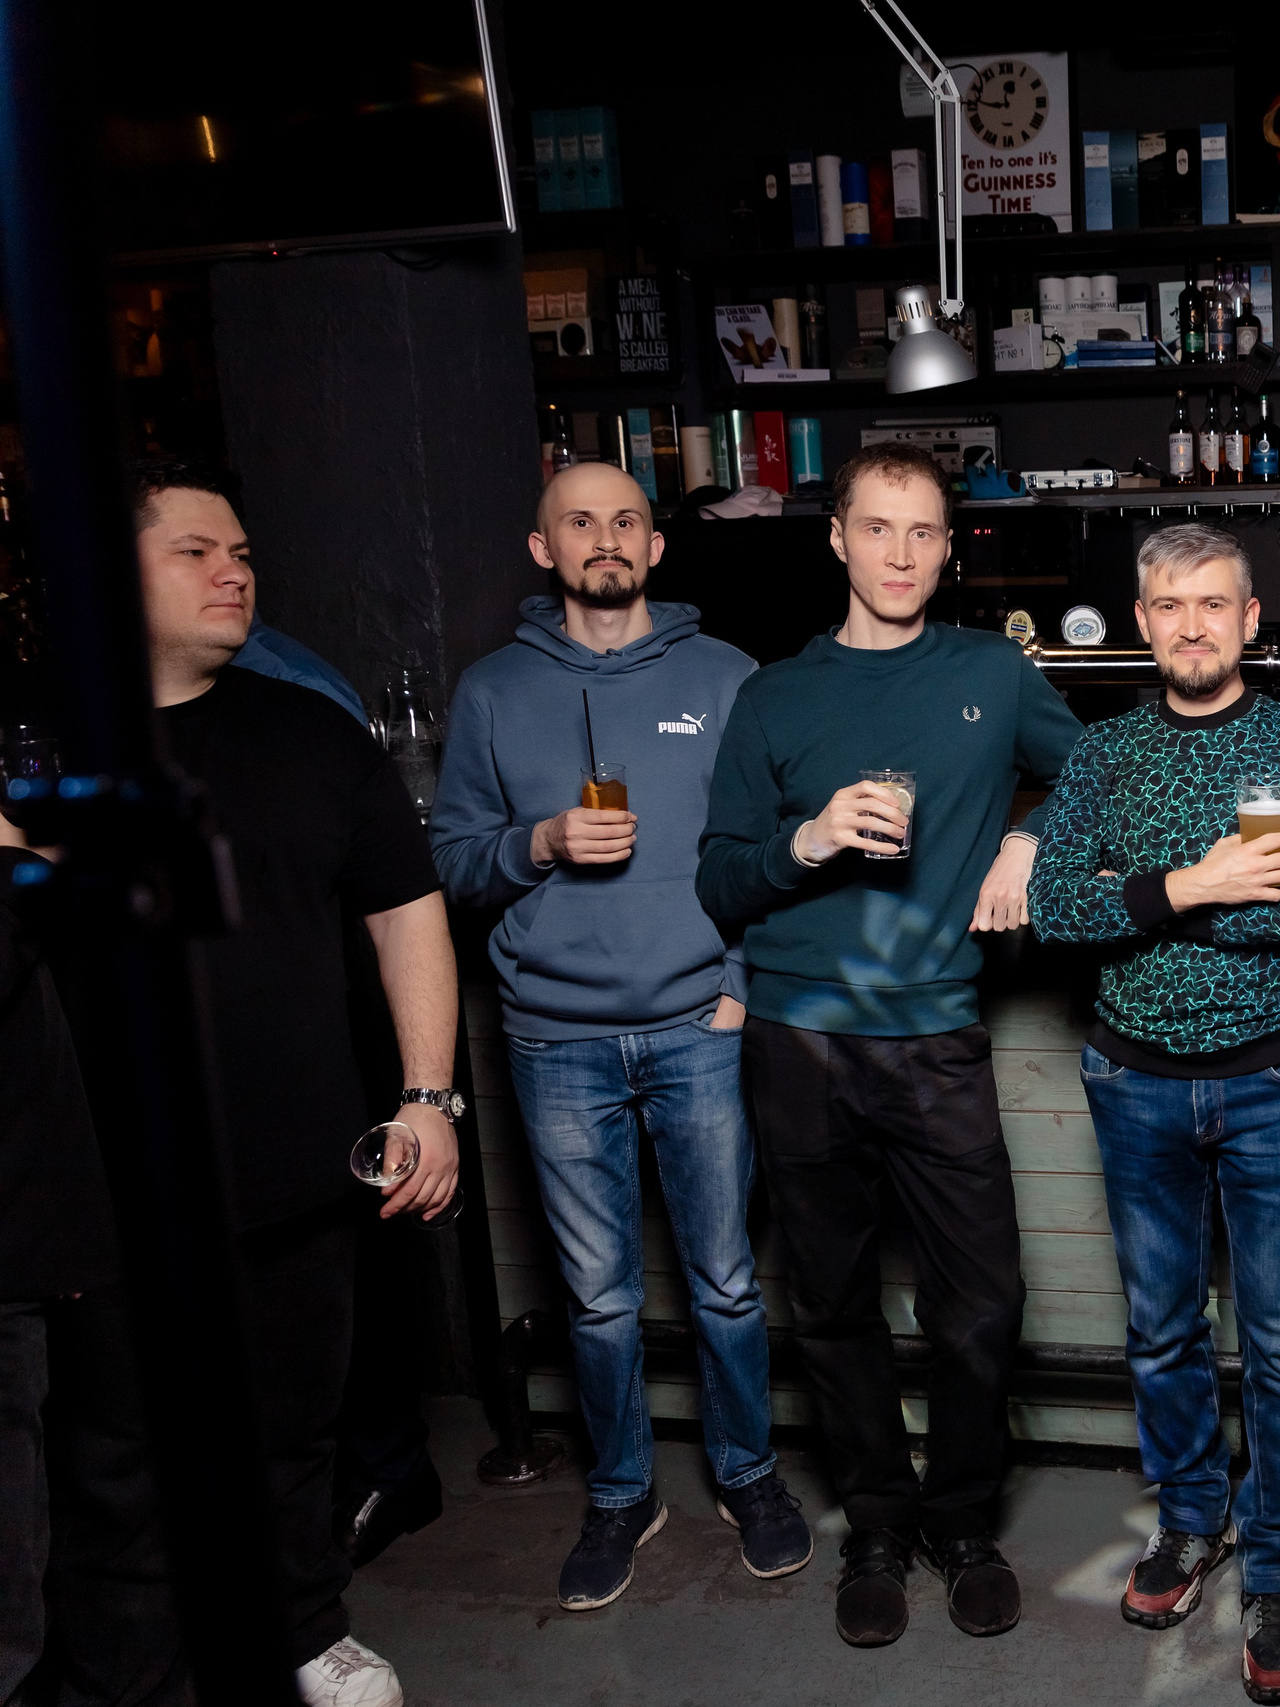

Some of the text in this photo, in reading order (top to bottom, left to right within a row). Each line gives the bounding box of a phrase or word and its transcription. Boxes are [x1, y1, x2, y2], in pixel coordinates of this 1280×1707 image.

[961, 151, 1057, 169] Ten to one it's
[964, 172, 1056, 193] GUINNESS
[988, 194, 1032, 213] TIME
[618, 278, 660, 296] A MEAL
[618, 297, 661, 312] WITHOUT
[619, 341, 669, 357] IS CALLED
[620, 358, 670, 373] BREAKFAST
[658, 722, 698, 735] PUMA
